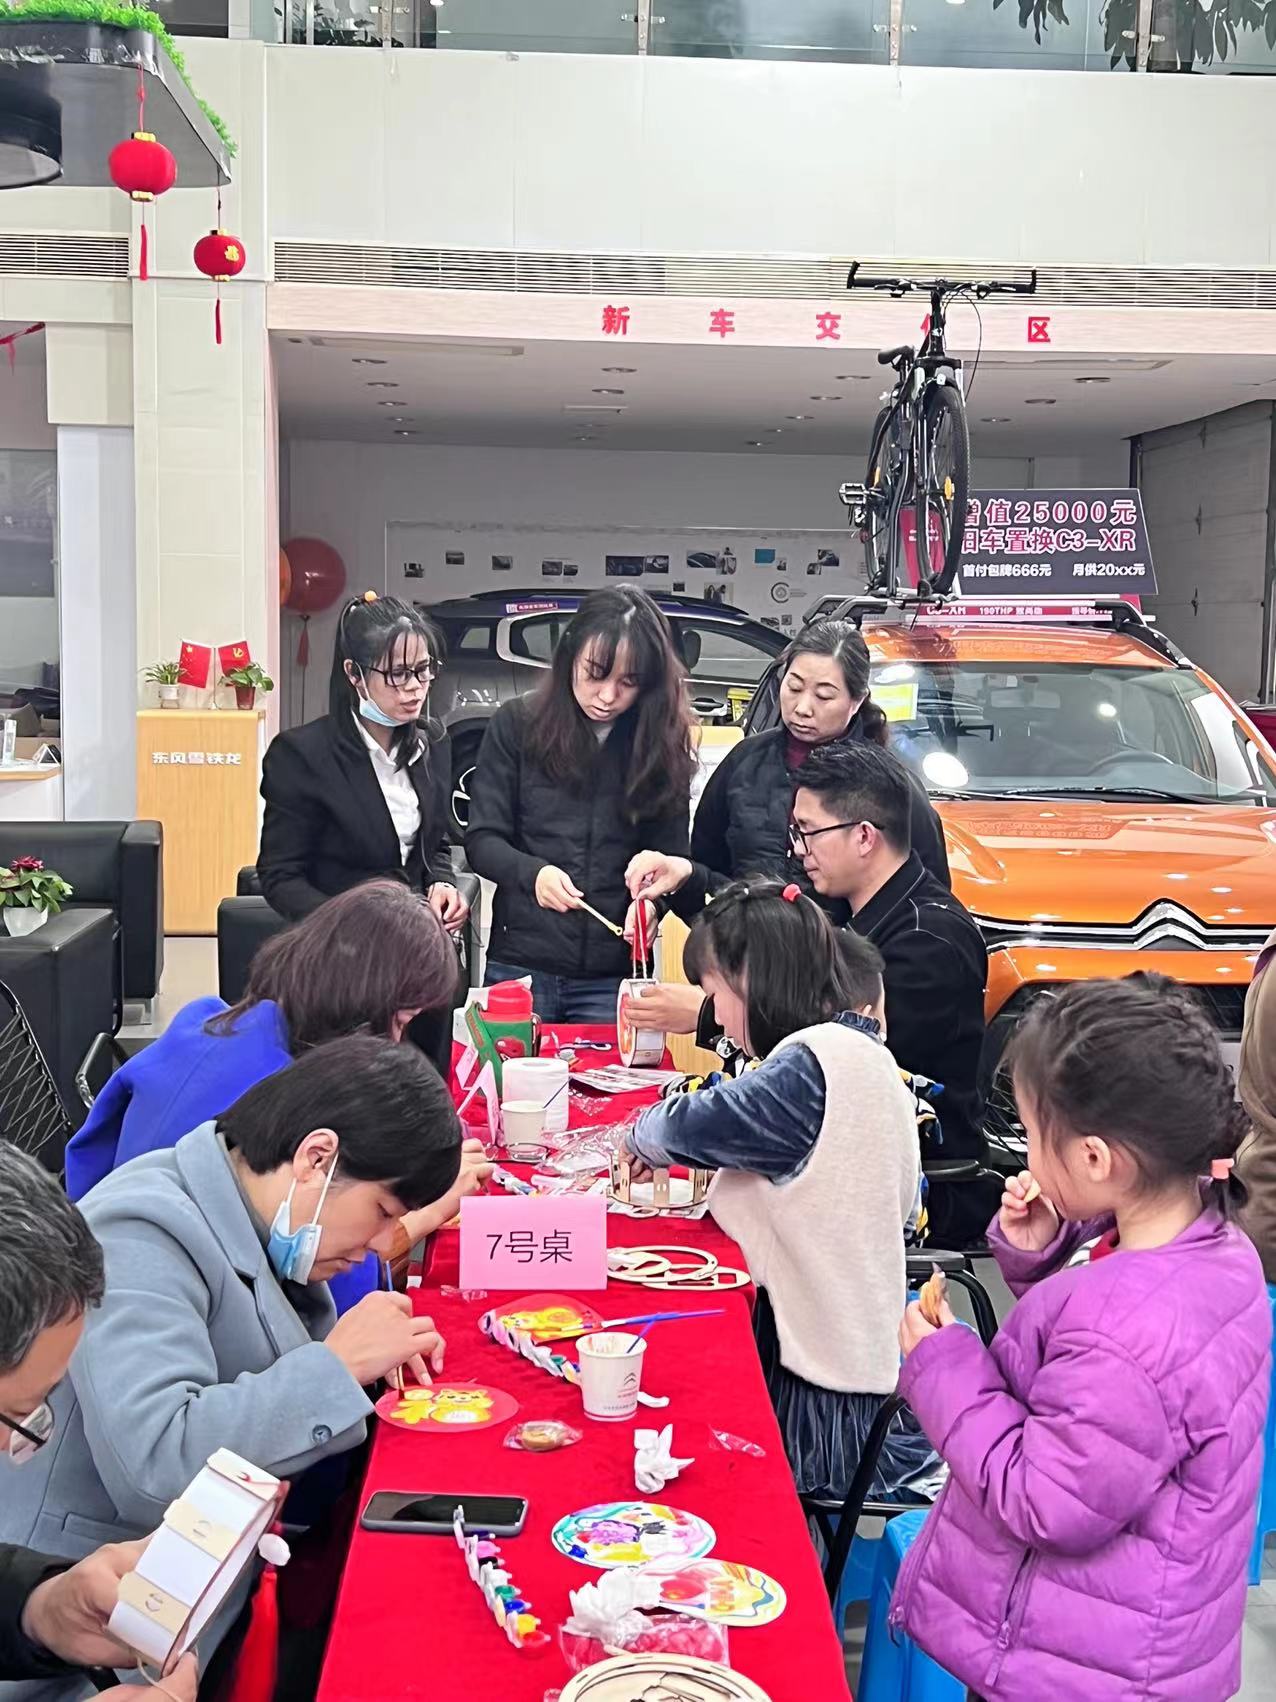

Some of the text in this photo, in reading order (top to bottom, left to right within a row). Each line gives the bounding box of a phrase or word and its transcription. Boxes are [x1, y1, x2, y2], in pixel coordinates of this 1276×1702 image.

[602, 305, 1051, 343] 新车交区
[963, 563, 1145, 577] 首付包牌666元 月供20xx元
[151, 751, 242, 765] 东风雪铁龙
[486, 1229, 573, 1264] 7号桌
